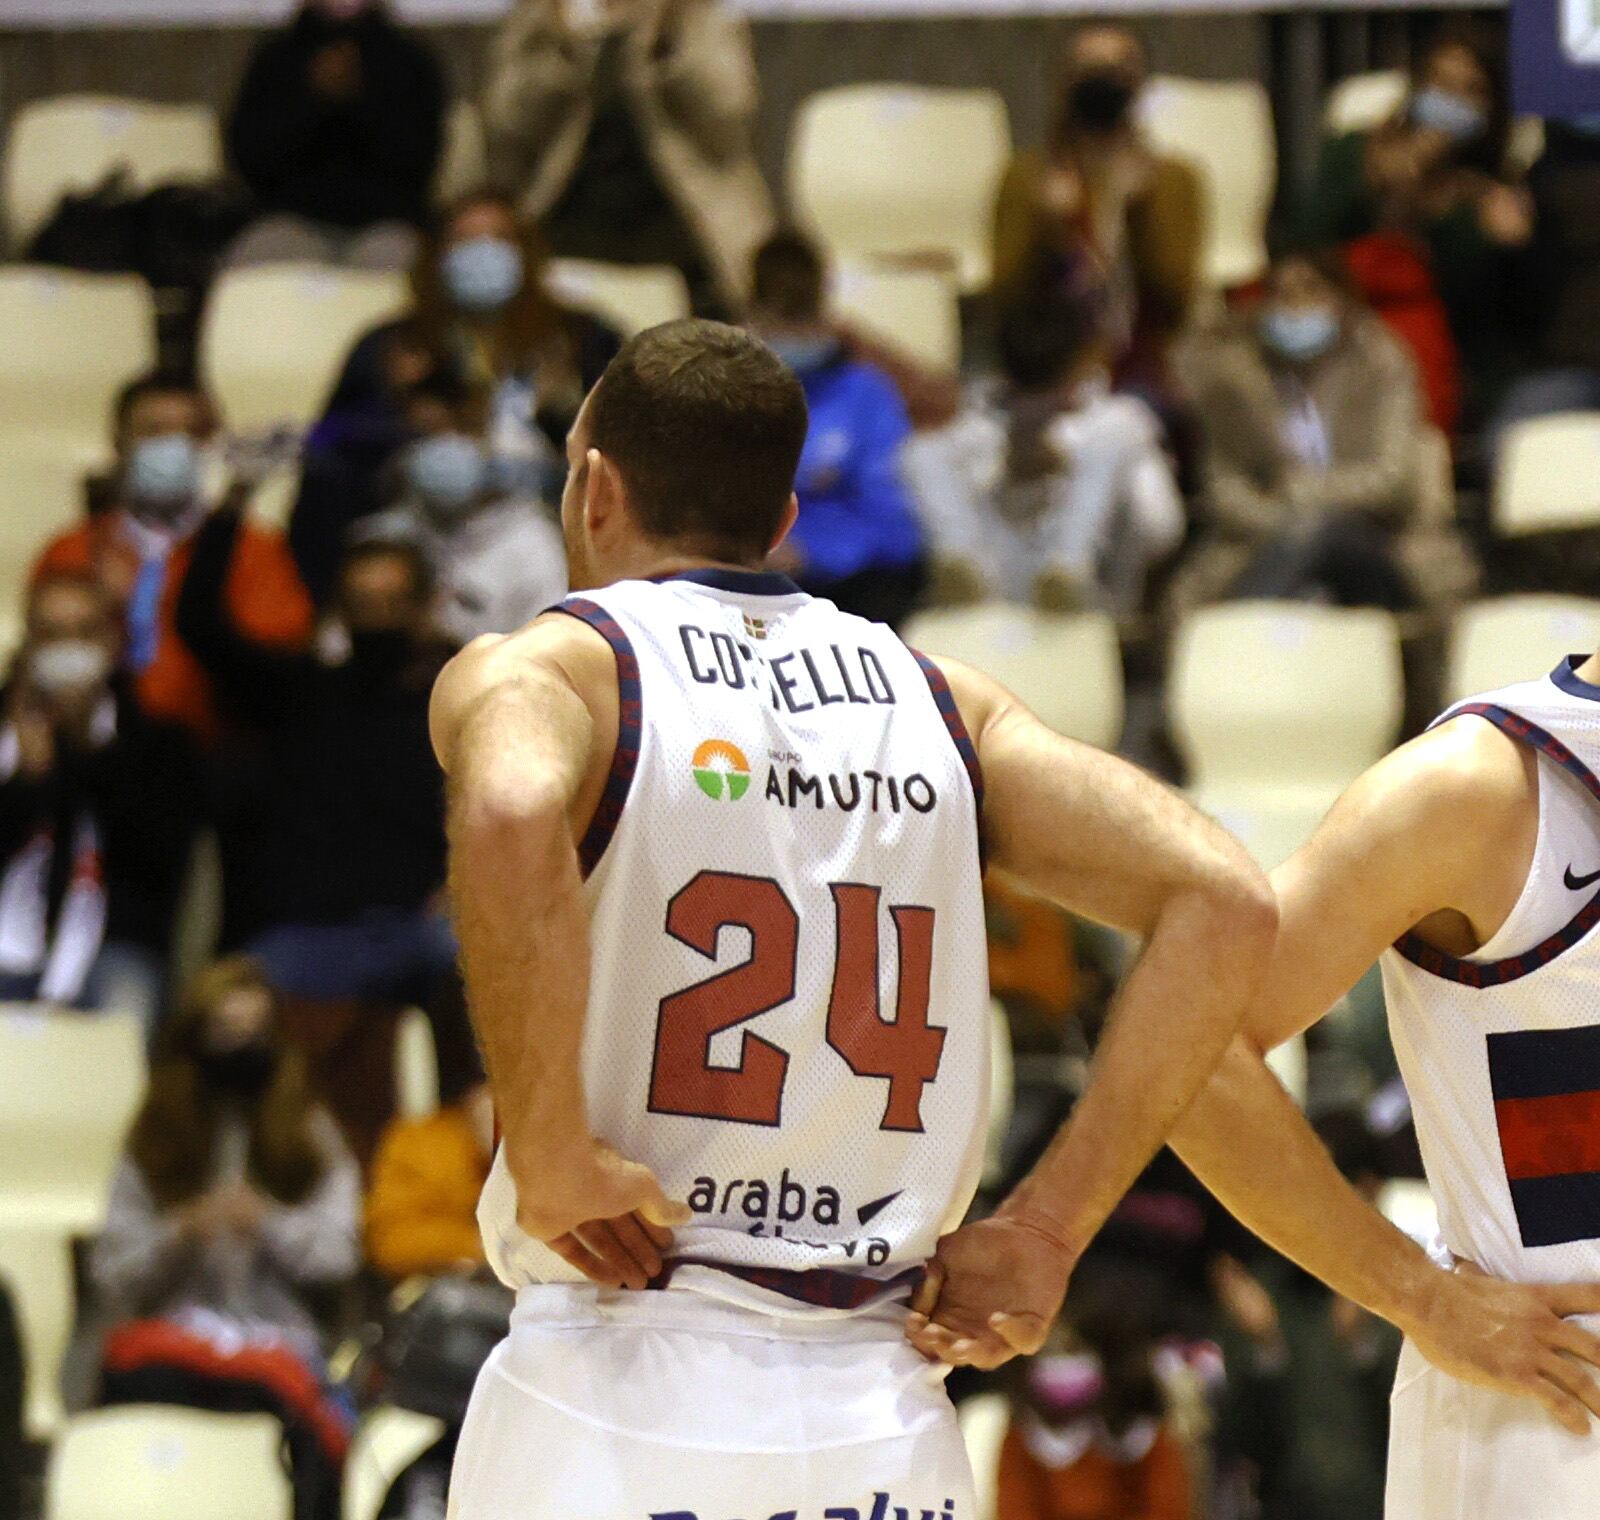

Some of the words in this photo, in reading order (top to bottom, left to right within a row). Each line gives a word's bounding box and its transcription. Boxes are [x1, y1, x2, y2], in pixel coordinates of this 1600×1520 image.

[679, 624, 896, 713] COELLO
[765, 766, 937, 813] AMUTIO
[648, 869, 948, 1133] 24
[688, 1168, 841, 1226] araba
